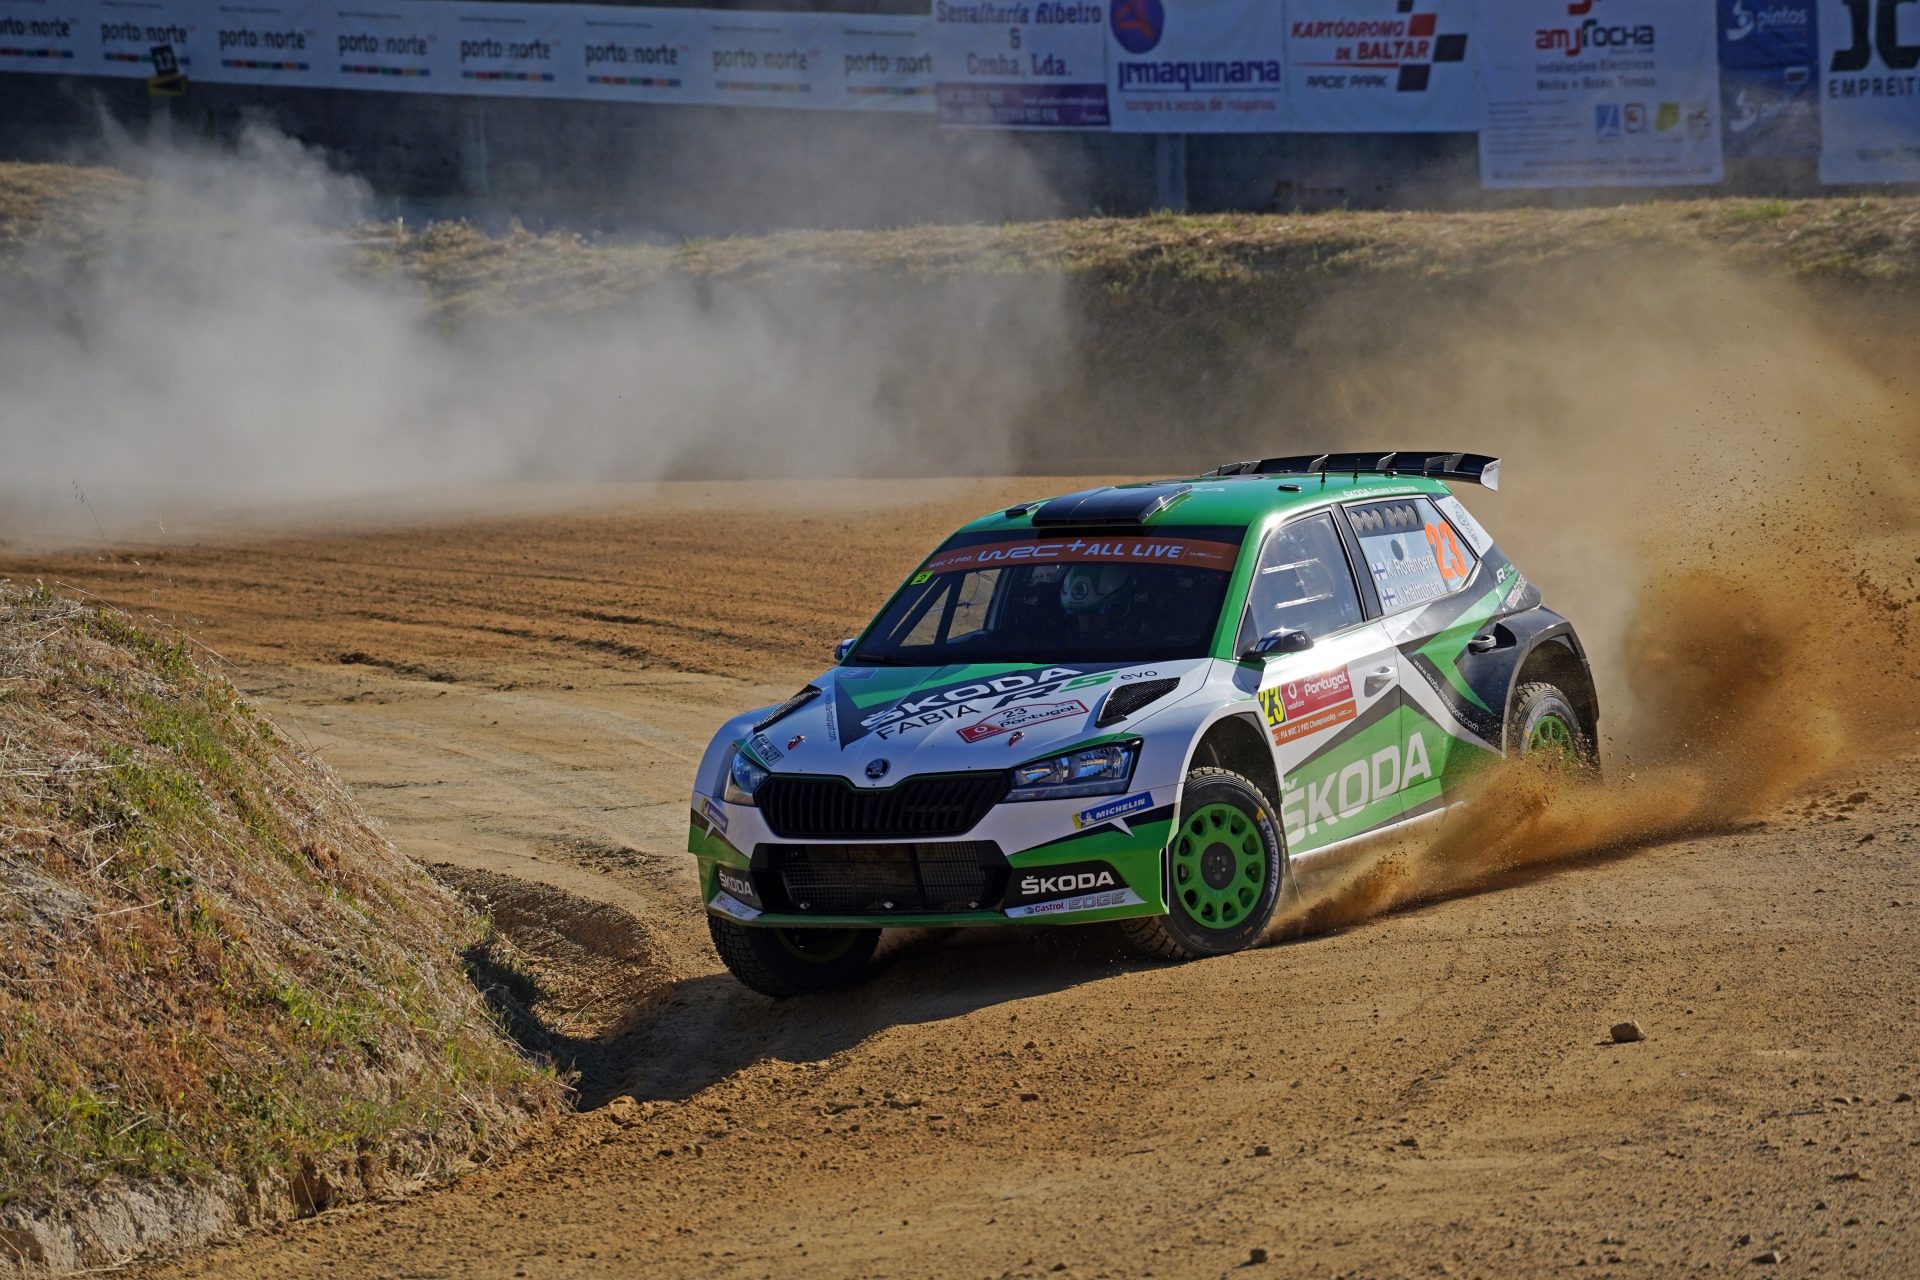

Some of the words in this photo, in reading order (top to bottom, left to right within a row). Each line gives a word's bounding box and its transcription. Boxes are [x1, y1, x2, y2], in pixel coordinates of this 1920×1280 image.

[1035, 2, 1102, 24] Ribeiro
[32, 17, 70, 38] norte
[102, 22, 140, 43] porto
[149, 24, 187, 43] norte
[219, 27, 257, 50] porto
[266, 29, 305, 49] norte
[1291, 18, 1405, 38] KARTÓDROMO
[339, 32, 378, 57] porto
[386, 34, 427, 55] norte
[461, 38, 501, 62] porto
[509, 39, 551, 60] norte
[586, 43, 628, 66] porto
[634, 44, 679, 65] norte
[1357, 41, 1430, 60] BALTAR
[712, 48, 757, 72] porto
[764, 50, 808, 70] norte
[844, 52, 889, 75] porto
[1031, 53, 1072, 76] Lda.
[1829, 77, 1920, 99] EMPREIT
[1084, 543, 1125, 556] ALL
[1131, 543, 1184, 558] LIVE
[1425, 521, 1467, 580] 23
[1304, 671, 1348, 697] Portugal
[875, 704, 981, 740] FABIA
[1120, 670, 1158, 681] evo
[999, 705, 1079, 728] Portugal
[1002, 708, 1028, 719] 23
[1259, 685, 1285, 726] 23
[1282, 732, 1432, 847] ŠKODA
[1095, 798, 1146, 819] MICHELIN
[718, 869, 754, 897] ŠKODA
[1021, 871, 1115, 895] ŠKODA
[1034, 902, 1065, 913] Castrol
[1068, 891, 1127, 910] EDGE
